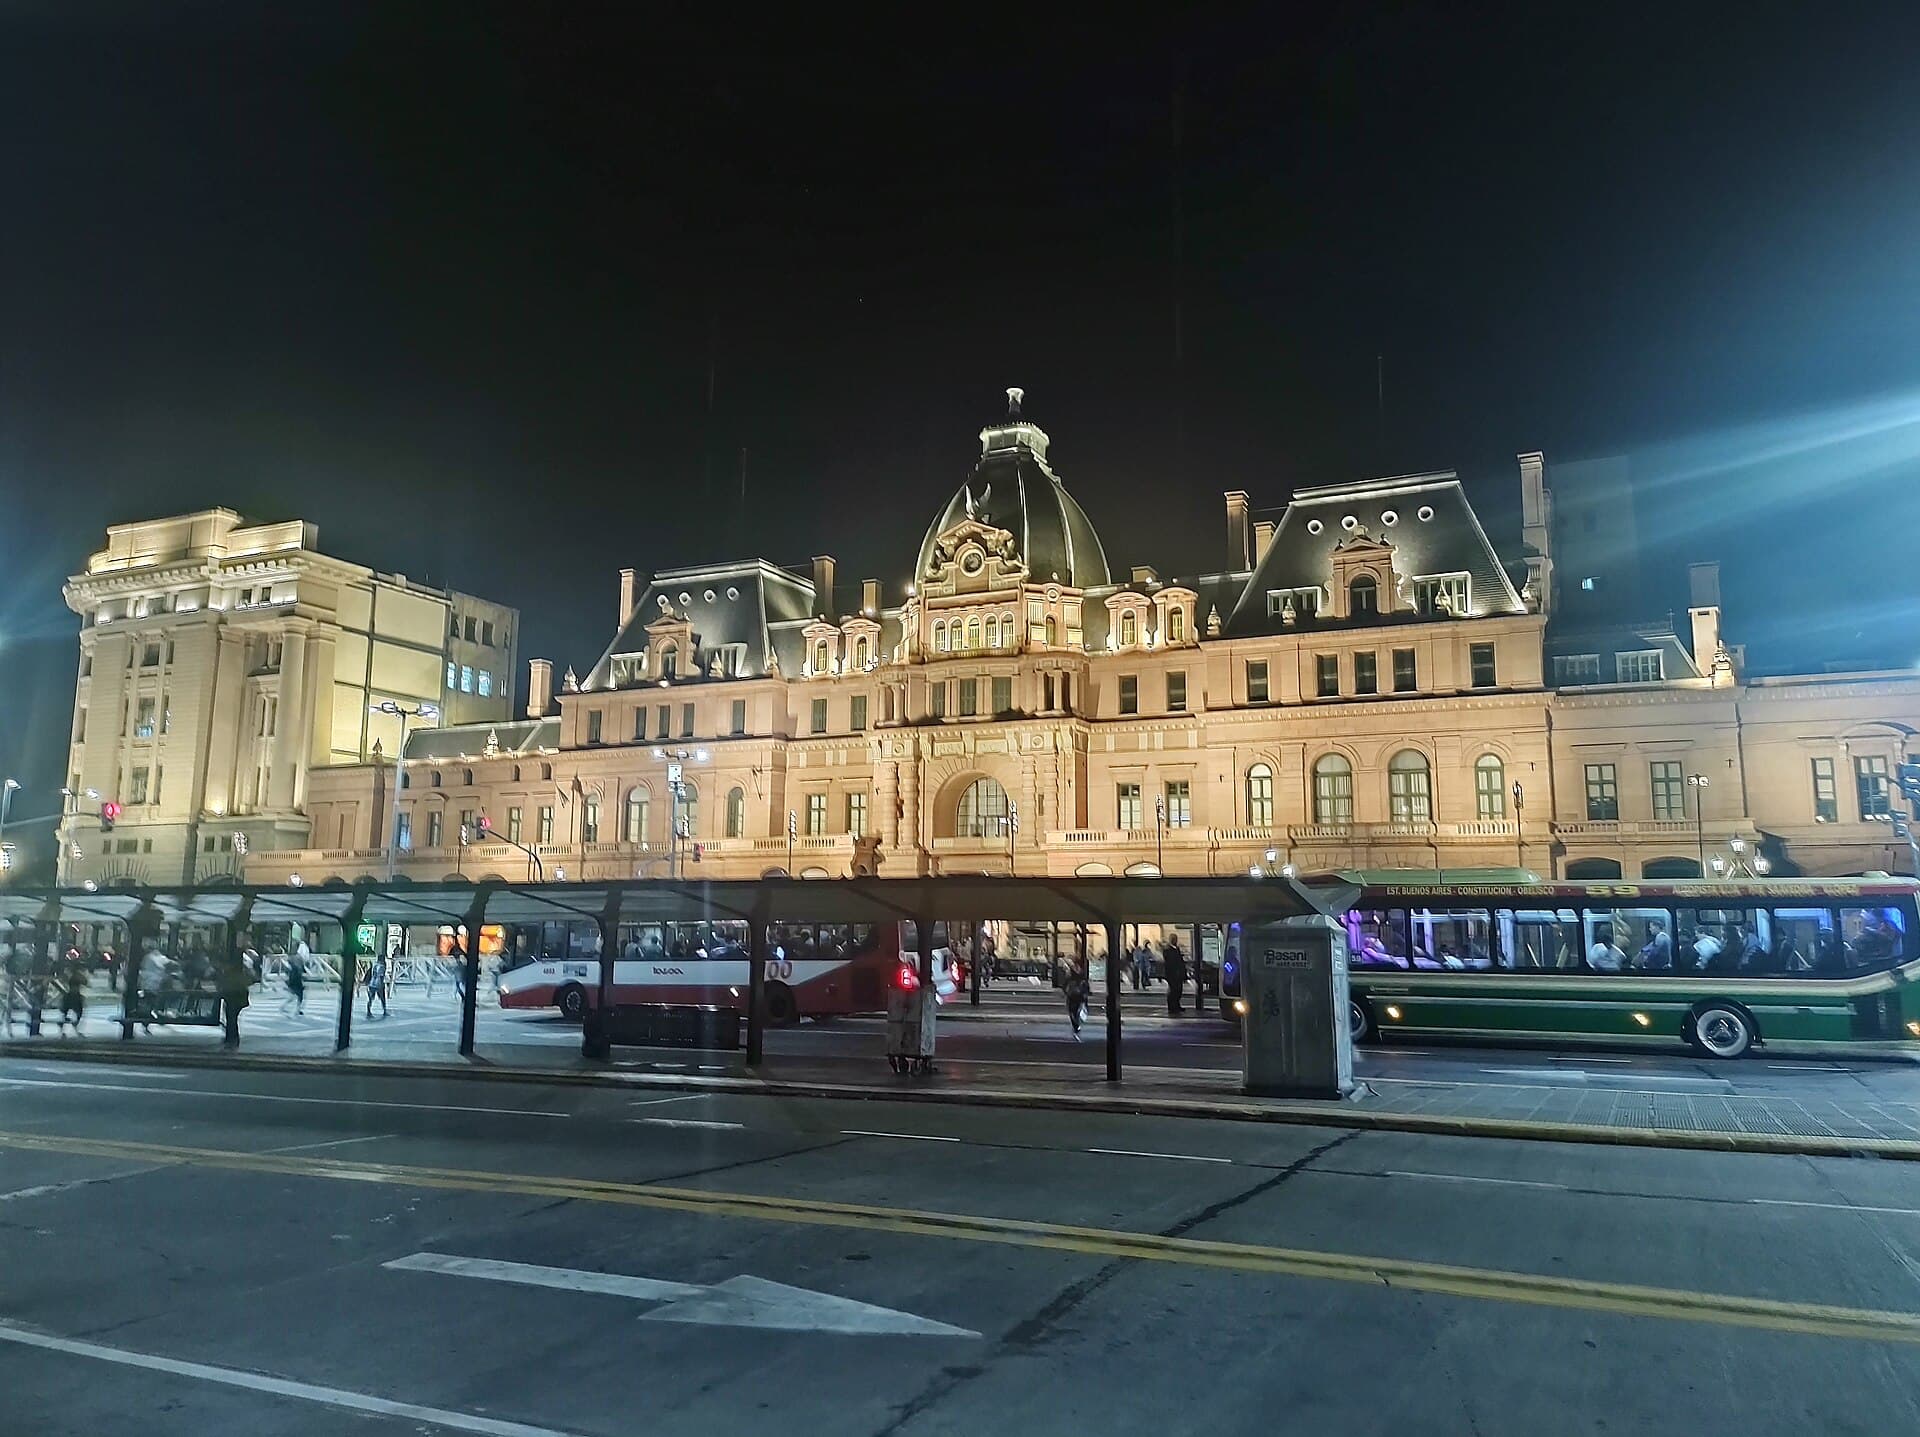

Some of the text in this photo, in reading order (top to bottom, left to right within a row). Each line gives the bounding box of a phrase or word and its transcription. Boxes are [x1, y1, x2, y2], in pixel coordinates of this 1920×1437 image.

[1386, 886, 1400, 895] EST.
[1402, 886, 1430, 895] BUENOS
[1431, 886, 1451, 895] AIRES
[1517, 886, 1554, 896] OBELISCO
[1585, 884, 1641, 898] 59
[1265, 950, 1307, 961] Basani
